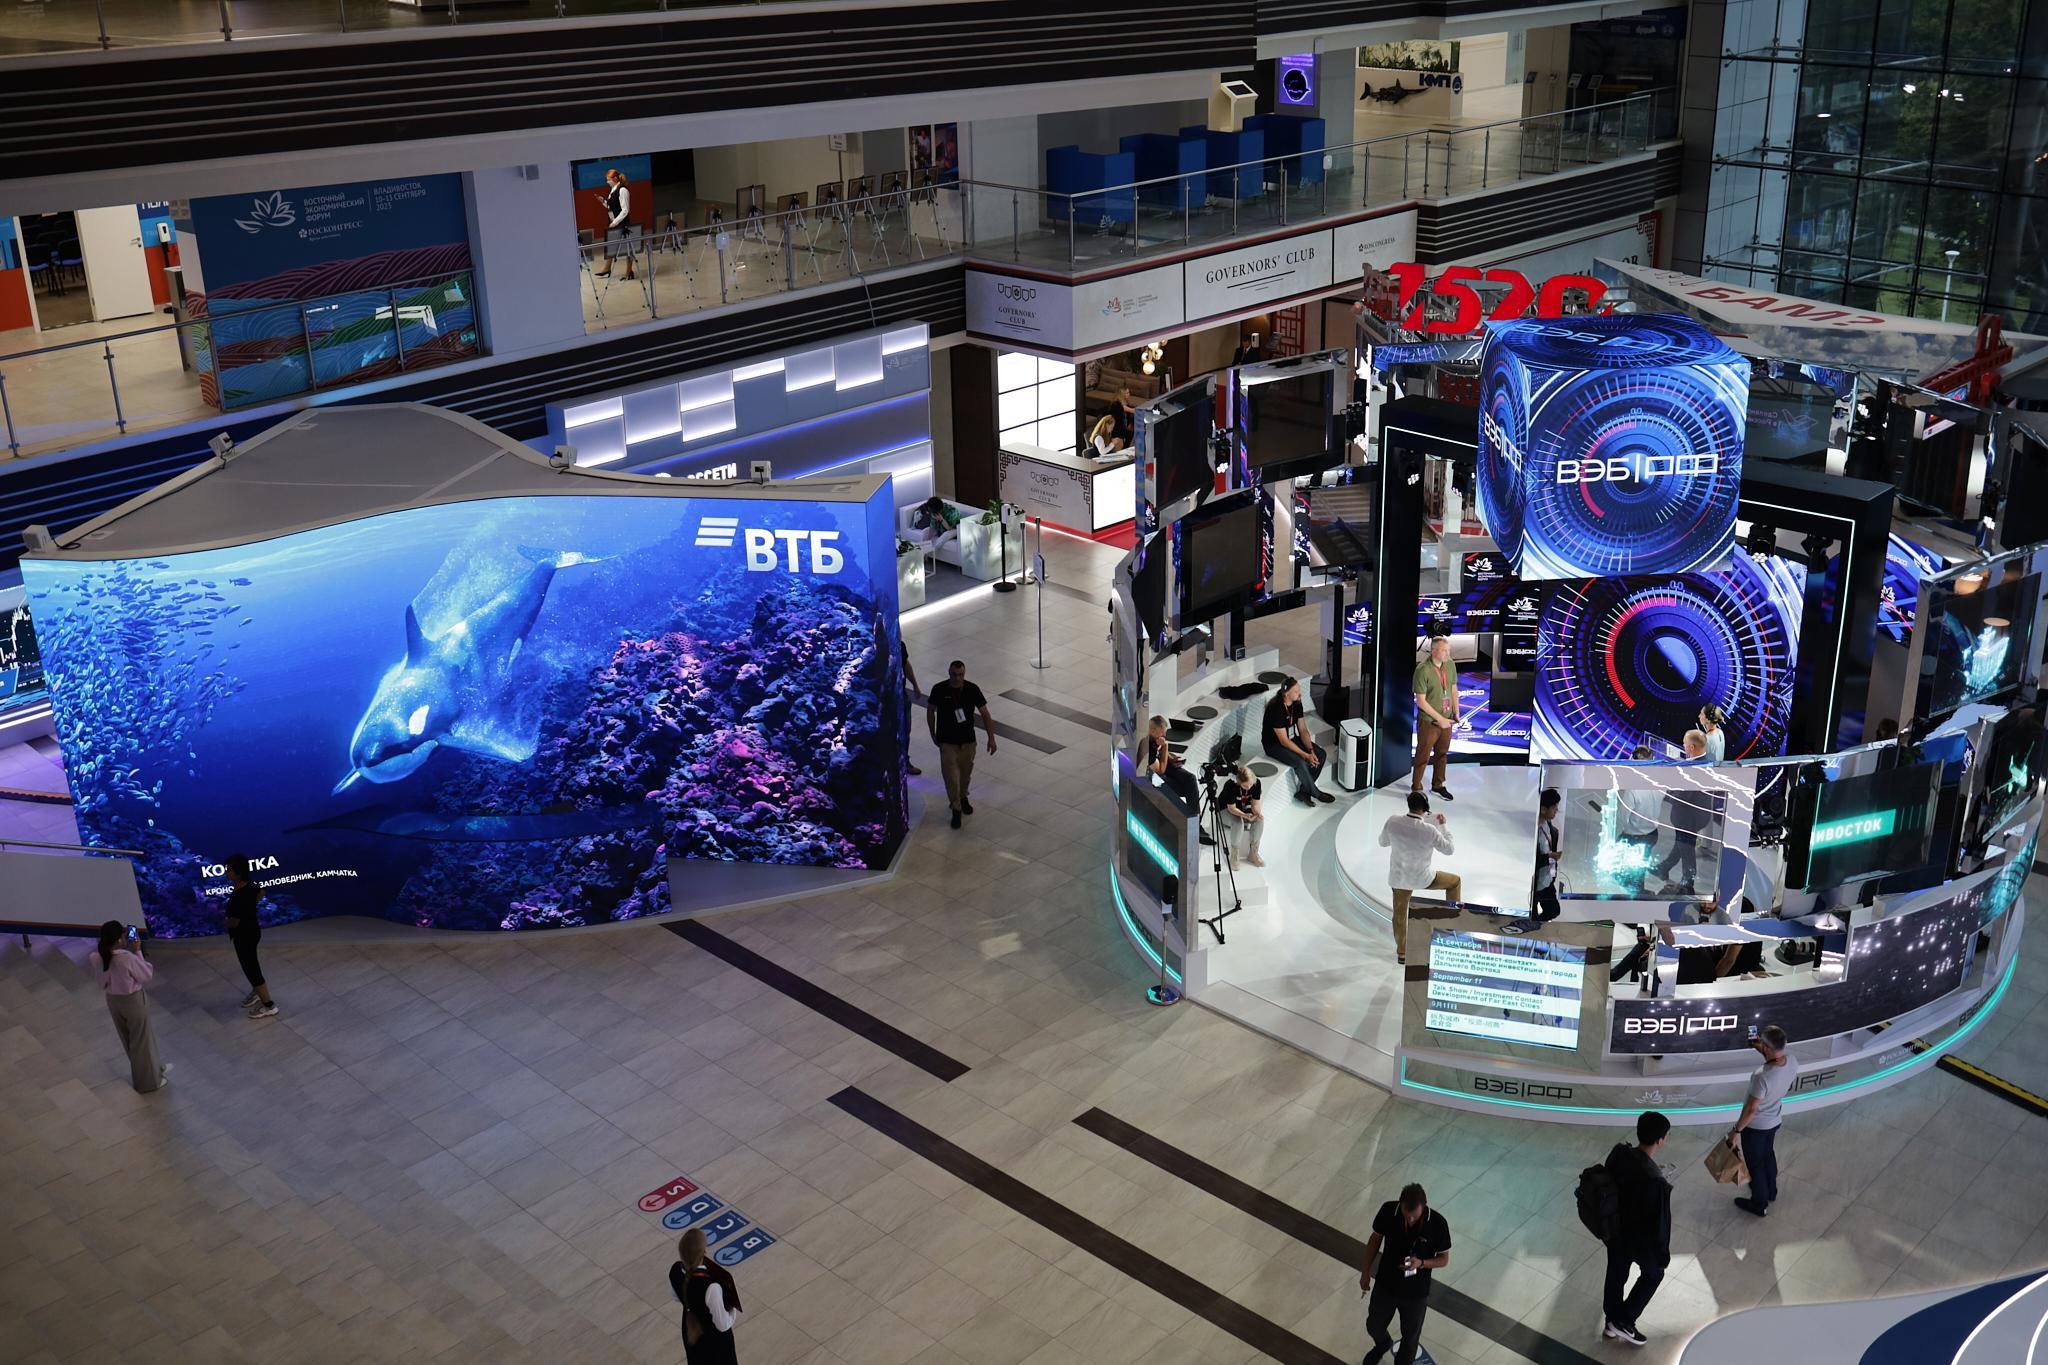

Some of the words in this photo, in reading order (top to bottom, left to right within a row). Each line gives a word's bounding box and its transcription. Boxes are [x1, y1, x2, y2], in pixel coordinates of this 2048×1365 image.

[373, 182, 421, 195] ВЛАДИВОСТОК
[394, 189, 426, 200] СЕНТЯБРЯ
[303, 192, 346, 206] ВОСТОЧНЫЙ
[304, 197, 365, 214] ЭКОНОМИЧЕСКИЙ
[305, 212, 331, 222] ФОРУМ
[308, 221, 363, 236] РОСКОНГРЕСС
[1286, 247, 1315, 265] CLUB
[1685, 287, 1886, 326] БАМ?
[1009, 316, 1026, 325] CLUB
[744, 528, 844, 574] ВТБ
[201, 855, 280, 878] КОТКА
[259, 871, 316, 889] ЗАПОВЕДНИК,
[316, 868, 358, 878] КАМЧАТКА
[1434, 948, 1470, 958] Интенсив
[1433, 960, 1469, 970] Дальнего
[1470, 964, 1501, 974] Востока
[1446, 957, 1497, 968] привлечению
[1551, 970, 1578, 978] города
[1433, 972, 1472, 984] September
[1432, 989, 1478, 1001] Development
[1520, 1002, 1541, 1010] Cities
[1448, 986, 1469, 994] Show
[1473, 989, 1513, 1000] Investment
[1514, 995, 1543, 1005] Contact
[666, 1185, 686, 1196] S
[691, 1201, 710, 1213] D
[716, 1218, 735, 1230] C
[743, 1236, 762, 1249] B
